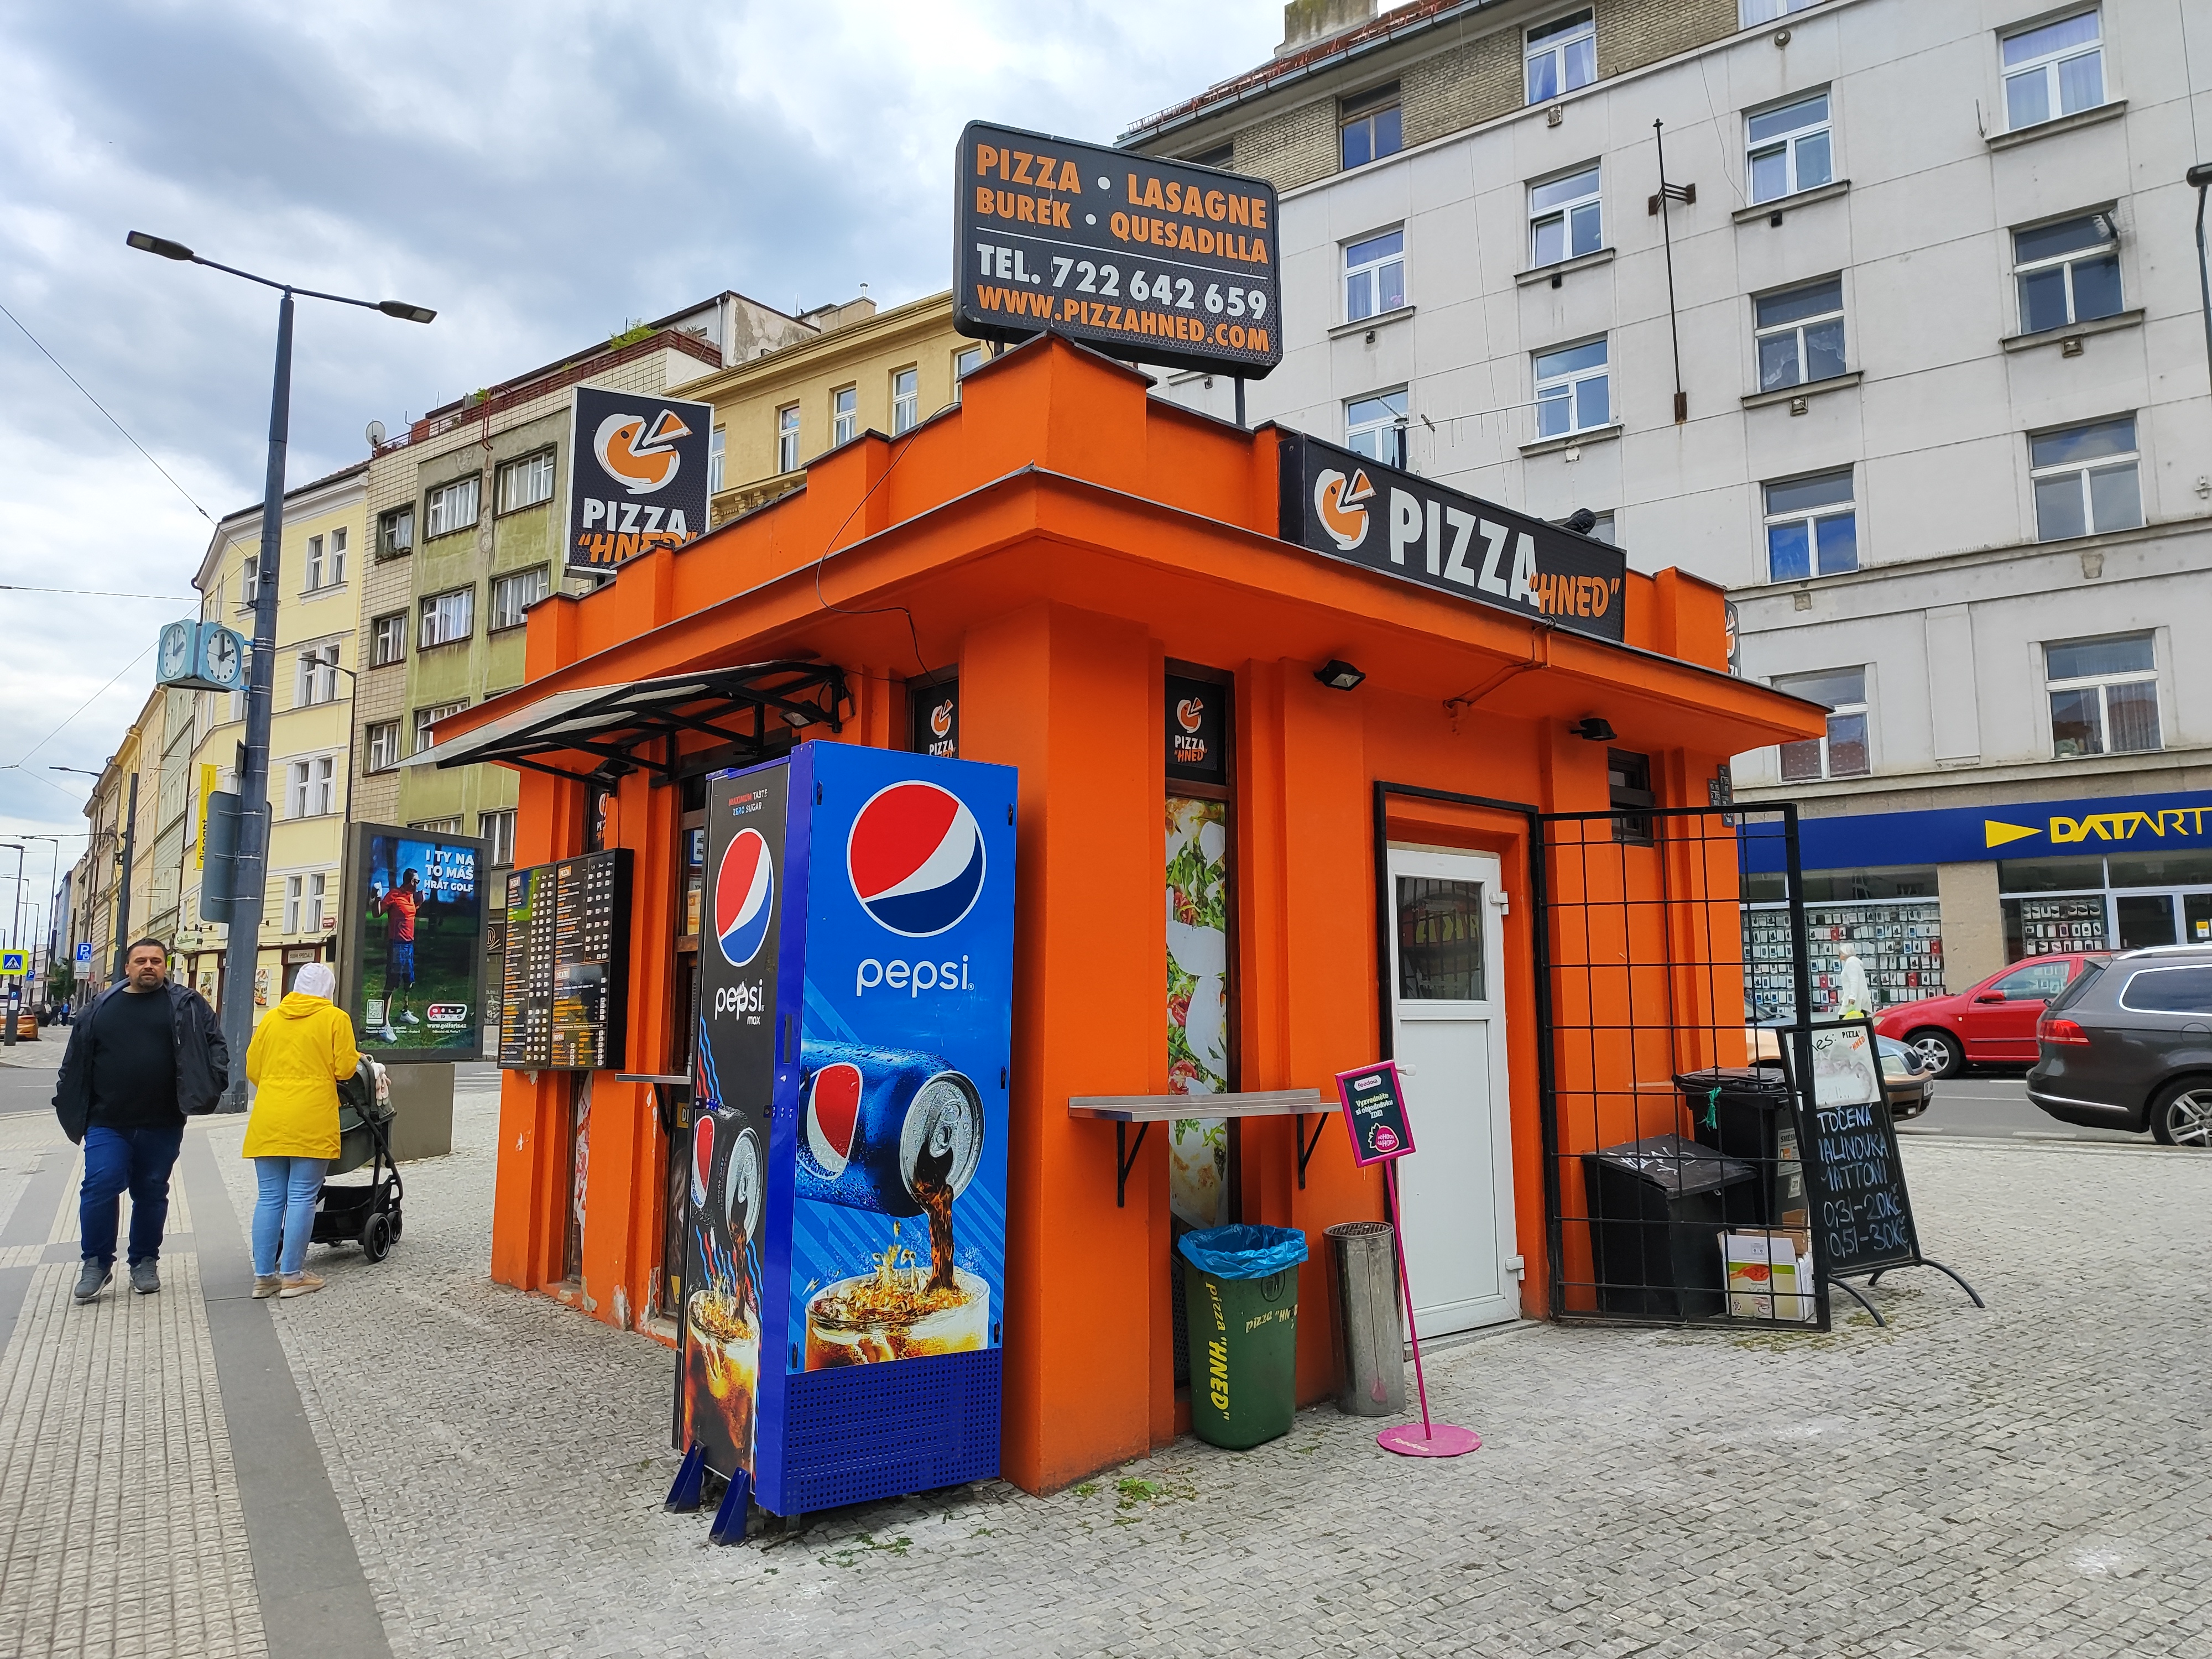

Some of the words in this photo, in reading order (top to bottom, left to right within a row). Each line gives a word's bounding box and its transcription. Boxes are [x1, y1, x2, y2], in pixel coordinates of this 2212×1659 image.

[977, 144, 1081, 194] PIZZA
[1128, 174, 1267, 229] LASAGNE
[977, 186, 1072, 228] BUREK
[1110, 211, 1268, 264] QUESADILLA
[977, 243, 1041, 284] TEL.
[1052, 256, 1119, 296] 722
[1130, 270, 1194, 310] 642
[1204, 283, 1267, 320] 659
[977, 284, 1269, 352] WWW.PIZZAHNED.COM
[583, 498, 687, 540] PIZZA
[1390, 487, 1540, 607] PIZZA
[929, 739, 953, 756] PIZZA
[1175, 734, 1204, 752] PIZZA
[728, 793, 752, 806] MAXIMUM
[753, 789, 768, 800] TASTE
[732, 806, 745, 816] ZERO
[745, 801, 762, 813] SUGAR
[2049, 807, 2212, 843] DATART
[426, 849, 431, 861] I
[435, 850, 452, 863] TY
[456, 853, 474, 866] NA
[425, 864, 443, 877] TO
[446, 865, 474, 880] MÁŠ
[424, 879, 449, 890] HRÁT
[450, 882, 474, 892] GOLF
[80, 945, 90, 956] P
[857, 954, 969, 998] pepsi
[714, 978, 764, 1021] pepsi
[747, 1015, 761, 1026] max
[1841, 1030, 1860, 1039] PIZZA
[1358, 1079, 1378, 1089] foodora
[1361, 1099, 1394, 1114] objednávku
[1817, 1103, 1873, 1134] TOČENÁ
[1205, 1281, 1226, 1331] pizza
[1245, 1310, 1272, 1334] pizza
